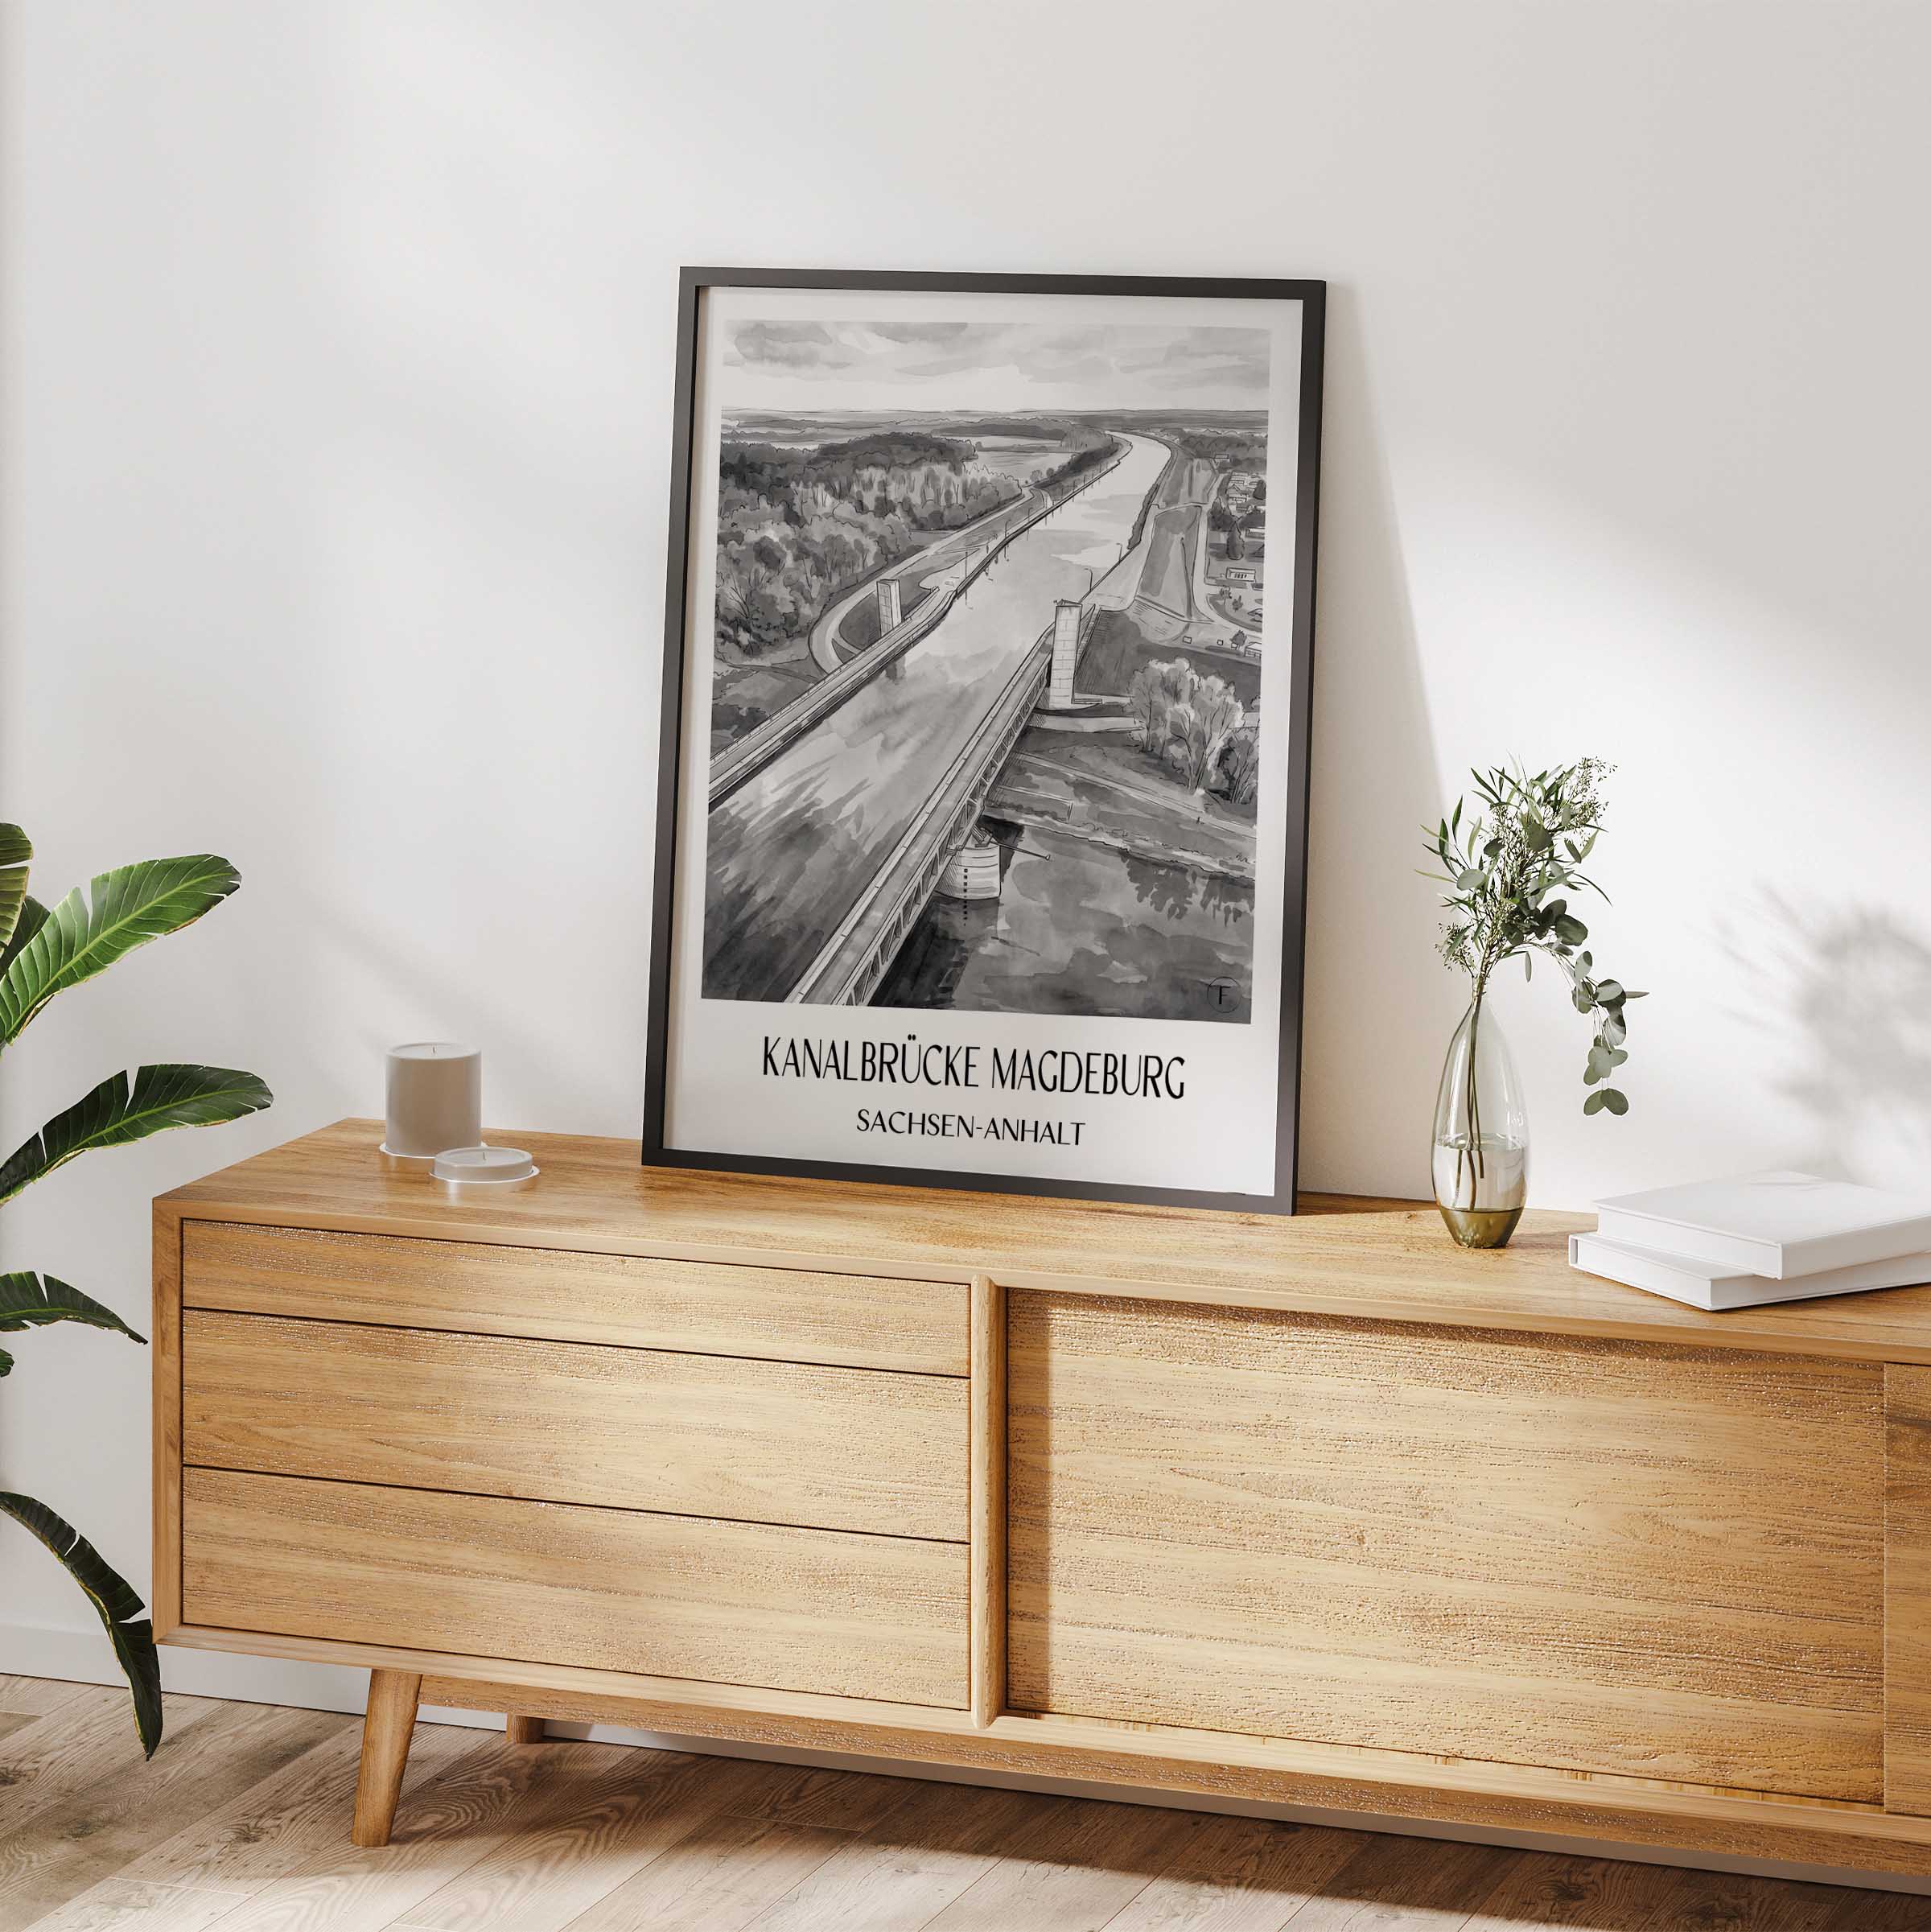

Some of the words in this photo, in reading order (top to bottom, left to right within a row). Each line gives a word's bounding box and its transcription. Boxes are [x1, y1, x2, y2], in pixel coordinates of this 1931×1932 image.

[763, 1034, 981, 1088] KANALBRÜCKE
[991, 1047, 1186, 1100] MAGDEBURG
[856, 1108, 1087, 1146] SACHSEN-ANHALT
